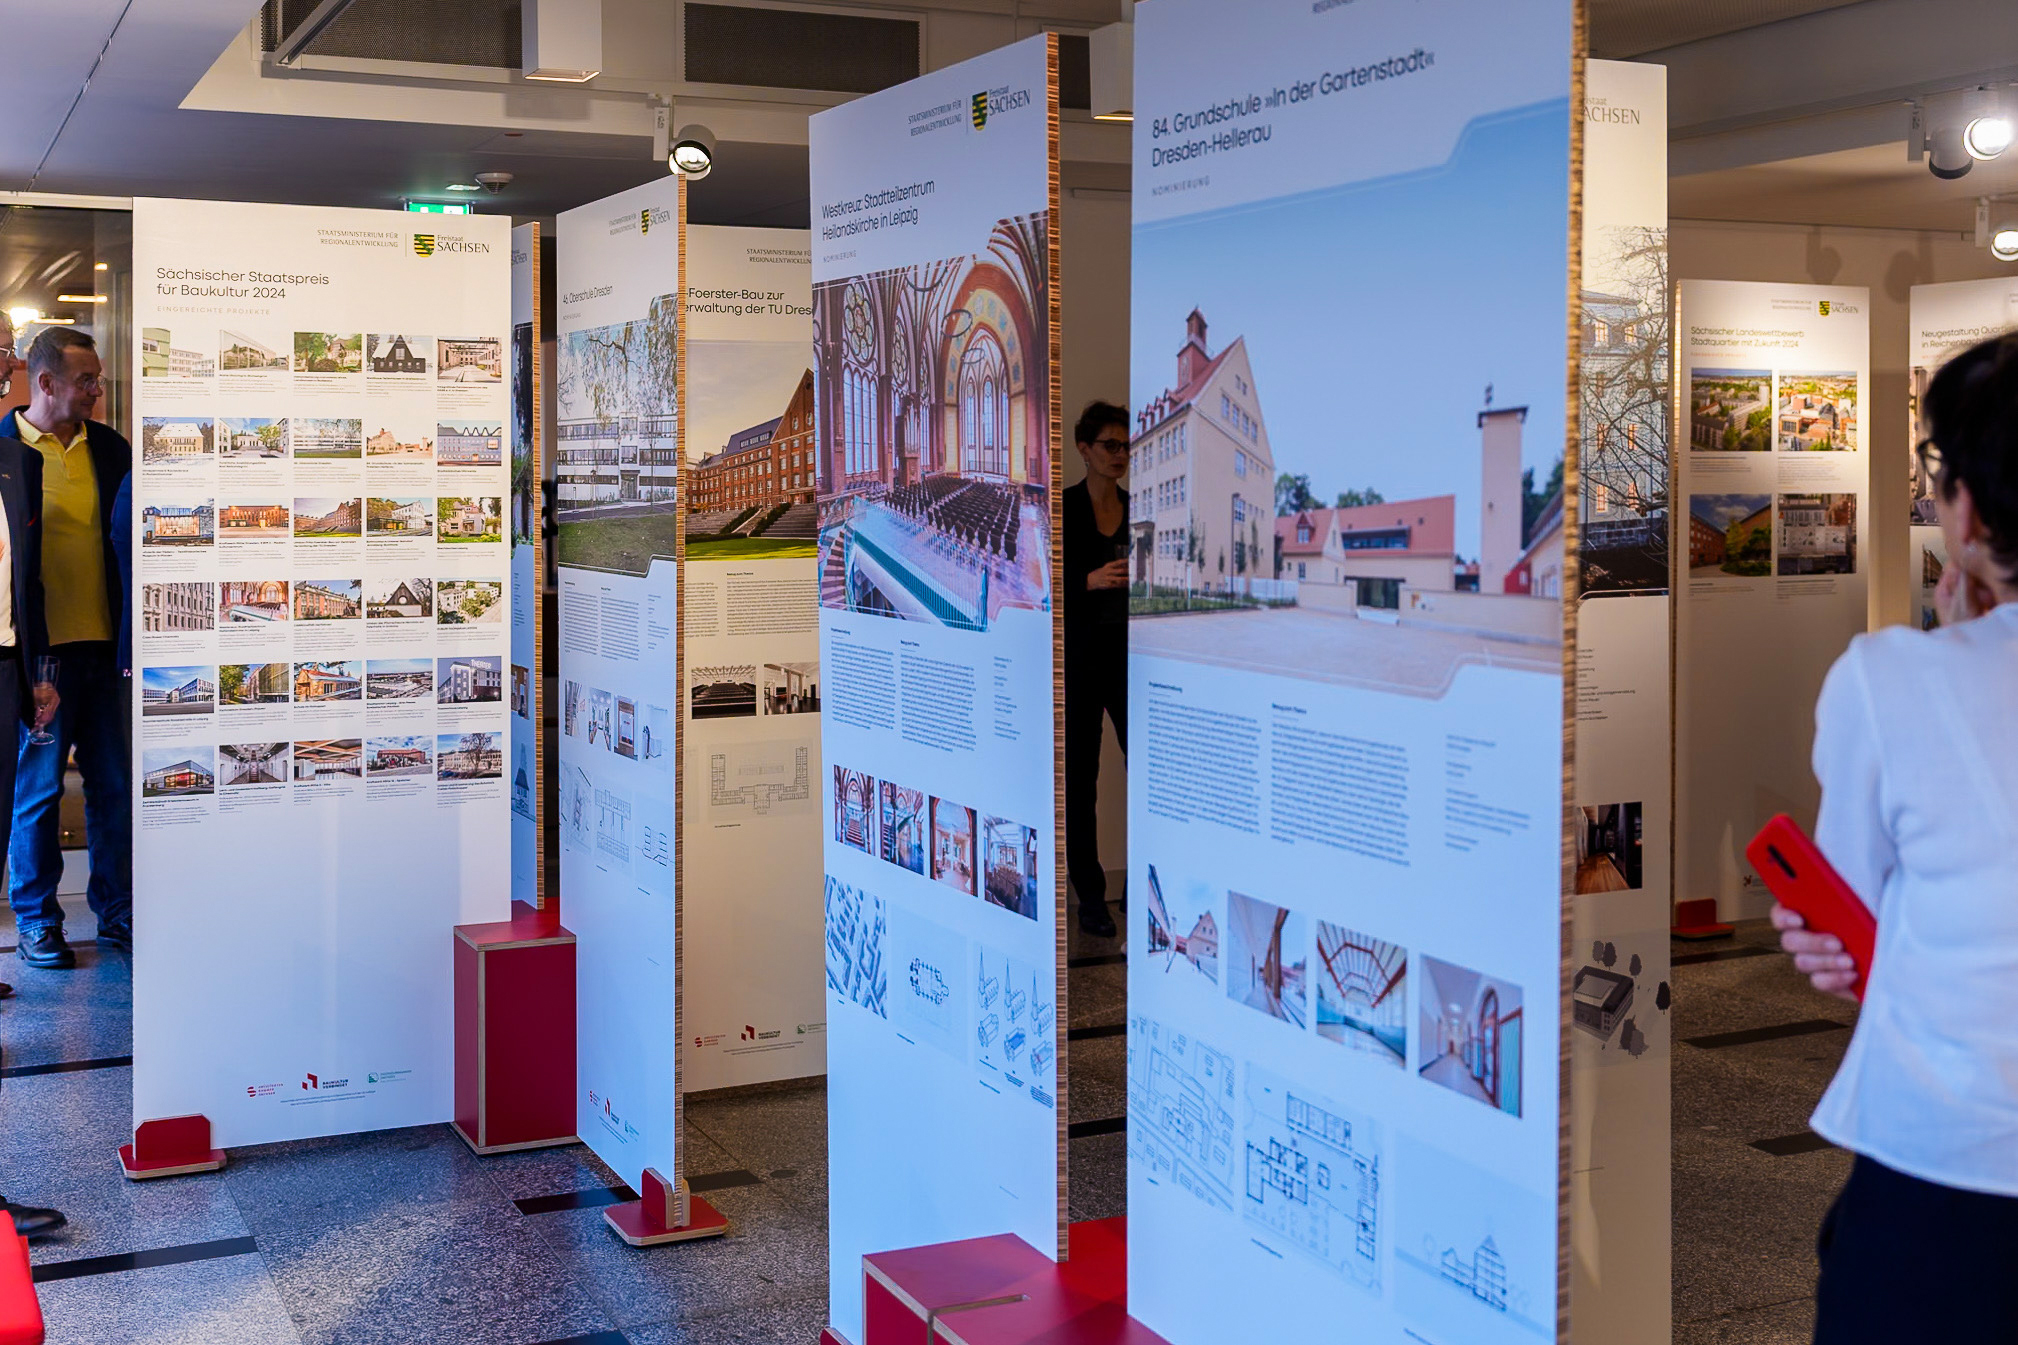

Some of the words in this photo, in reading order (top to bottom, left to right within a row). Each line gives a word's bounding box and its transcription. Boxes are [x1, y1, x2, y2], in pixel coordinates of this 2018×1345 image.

[989, 89, 1030, 116] SACHSEN
[1153, 117, 1171, 139] 84.
[1174, 94, 1261, 134] Grundschule
[1290, 80, 1316, 104] der
[1583, 106, 1640, 125] ACHSEN
[1152, 123, 1272, 167] Dresden-Hellerau
[1152, 176, 1210, 196] NOMINIERUNG
[864, 180, 935, 209] Stadtteilzentrum
[822, 215, 878, 241] Heilandskirche
[880, 213, 888, 228] in
[890, 206, 919, 227] Leipzig
[317, 230, 384, 238] STAATSMINISTERIUM
[321, 239, 398, 247] REGIONALENTWICKLUNG
[437, 242, 490, 253] SACHSEN
[157, 267, 245, 281] Sächsischer
[248, 271, 329, 286] Staatspreis
[157, 283, 177, 294] für
[181, 284, 249, 297] Baukultur
[253, 287, 286, 298] 2024
[686, 288, 764, 300] -Foerster-Bau
[767, 292, 784, 300] zur
[157, 306, 223, 314] EINGEREICHTE
[685, 302, 742, 316] erwaltung
[745, 304, 765, 313] der
[768, 304, 782, 314] TU
[786, 305, 812, 315] Dres
[1691, 326, 1735, 335] Sächsischer
[1736, 328, 1804, 338] Landeswettbewerb
[1922, 328, 1980, 339] Neugestaltung
[1691, 337, 1739, 347] Stadtquartier
